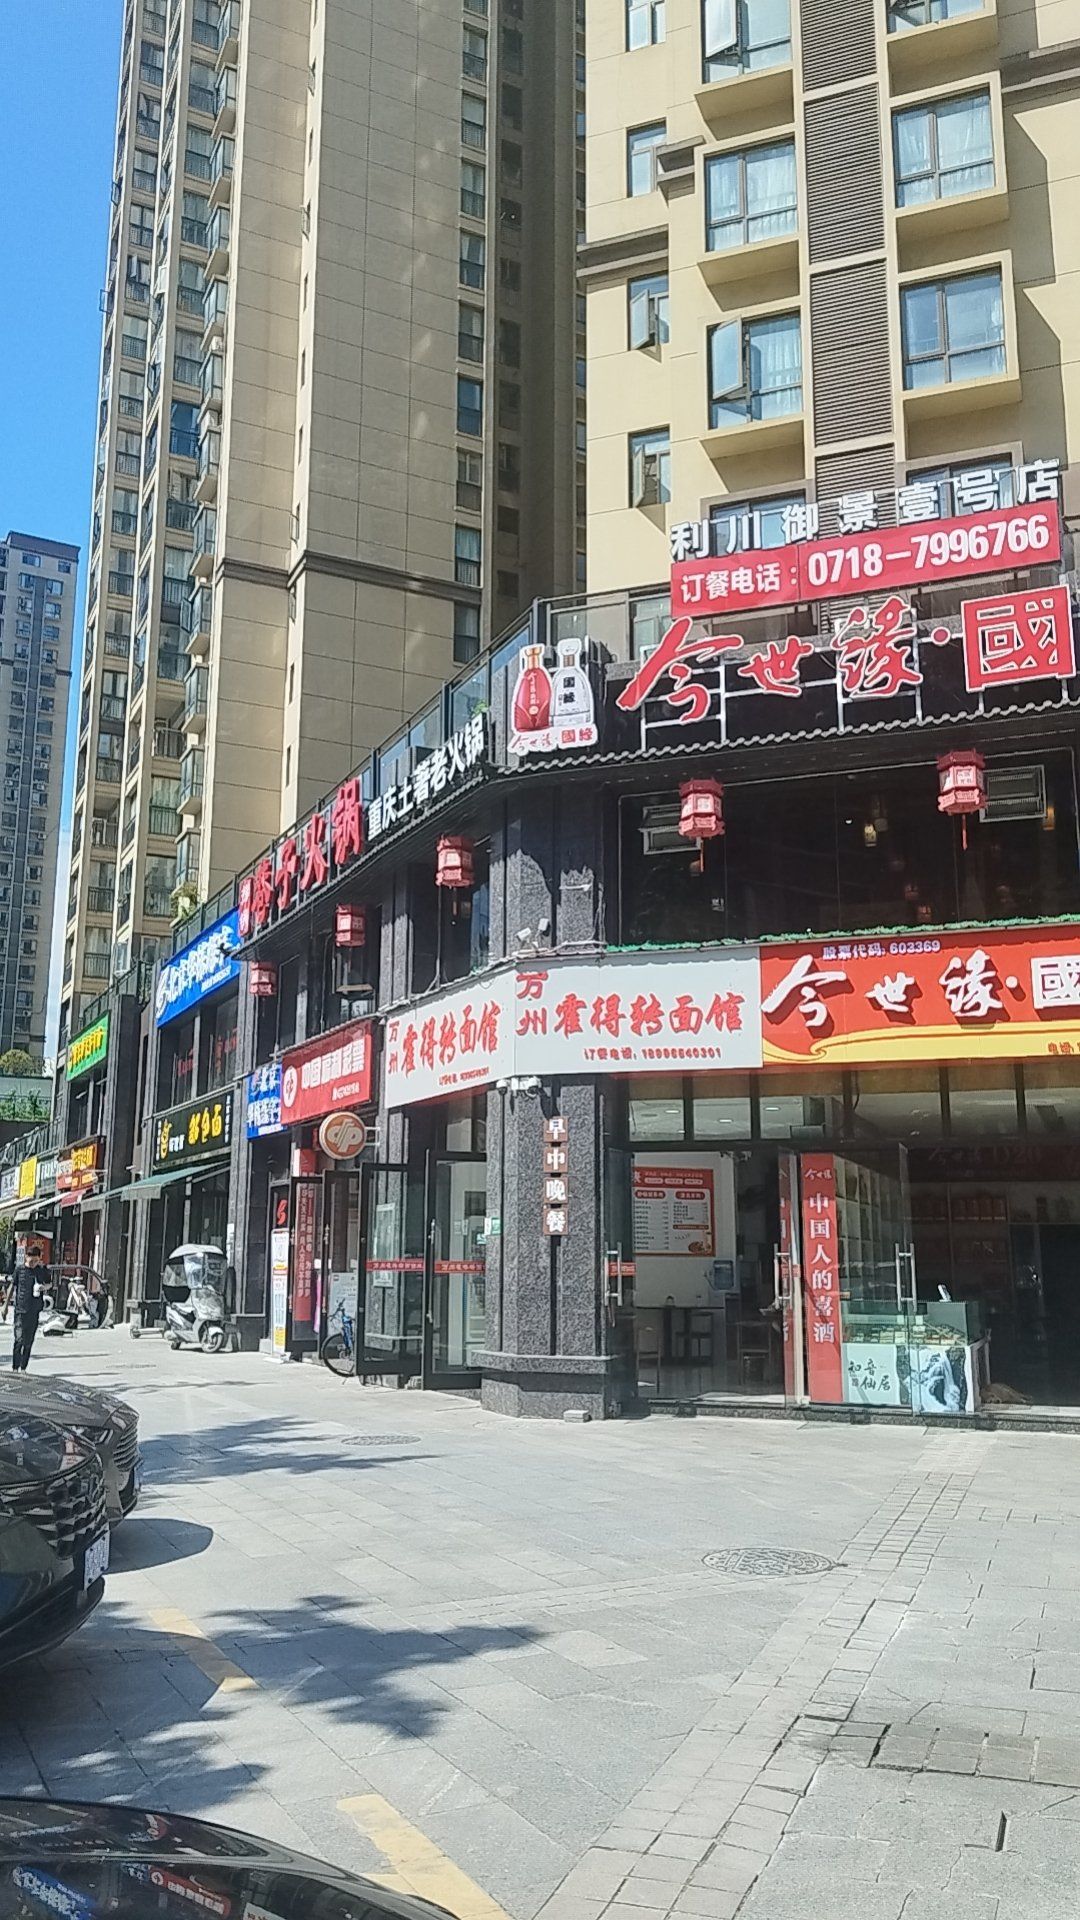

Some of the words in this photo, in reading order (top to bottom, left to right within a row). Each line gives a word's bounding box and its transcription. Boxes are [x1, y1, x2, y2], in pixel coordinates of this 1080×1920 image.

[670, 458, 1060, 561] 利川御景壹号店
[807, 514, 1050, 586] 0718-7996766
[367, 713, 485, 841] 重庆土著老火锅
[889, 940, 941, 955] 603369
[401, 1000, 501, 1077] 霍得转面馆
[515, 971, 549, 1036] 万州
[554, 992, 745, 1039] 霍得转面馆
[546, 1118, 567, 1233] 早中晚餐
[809, 1192, 835, 1343] 中国人的喜酒
